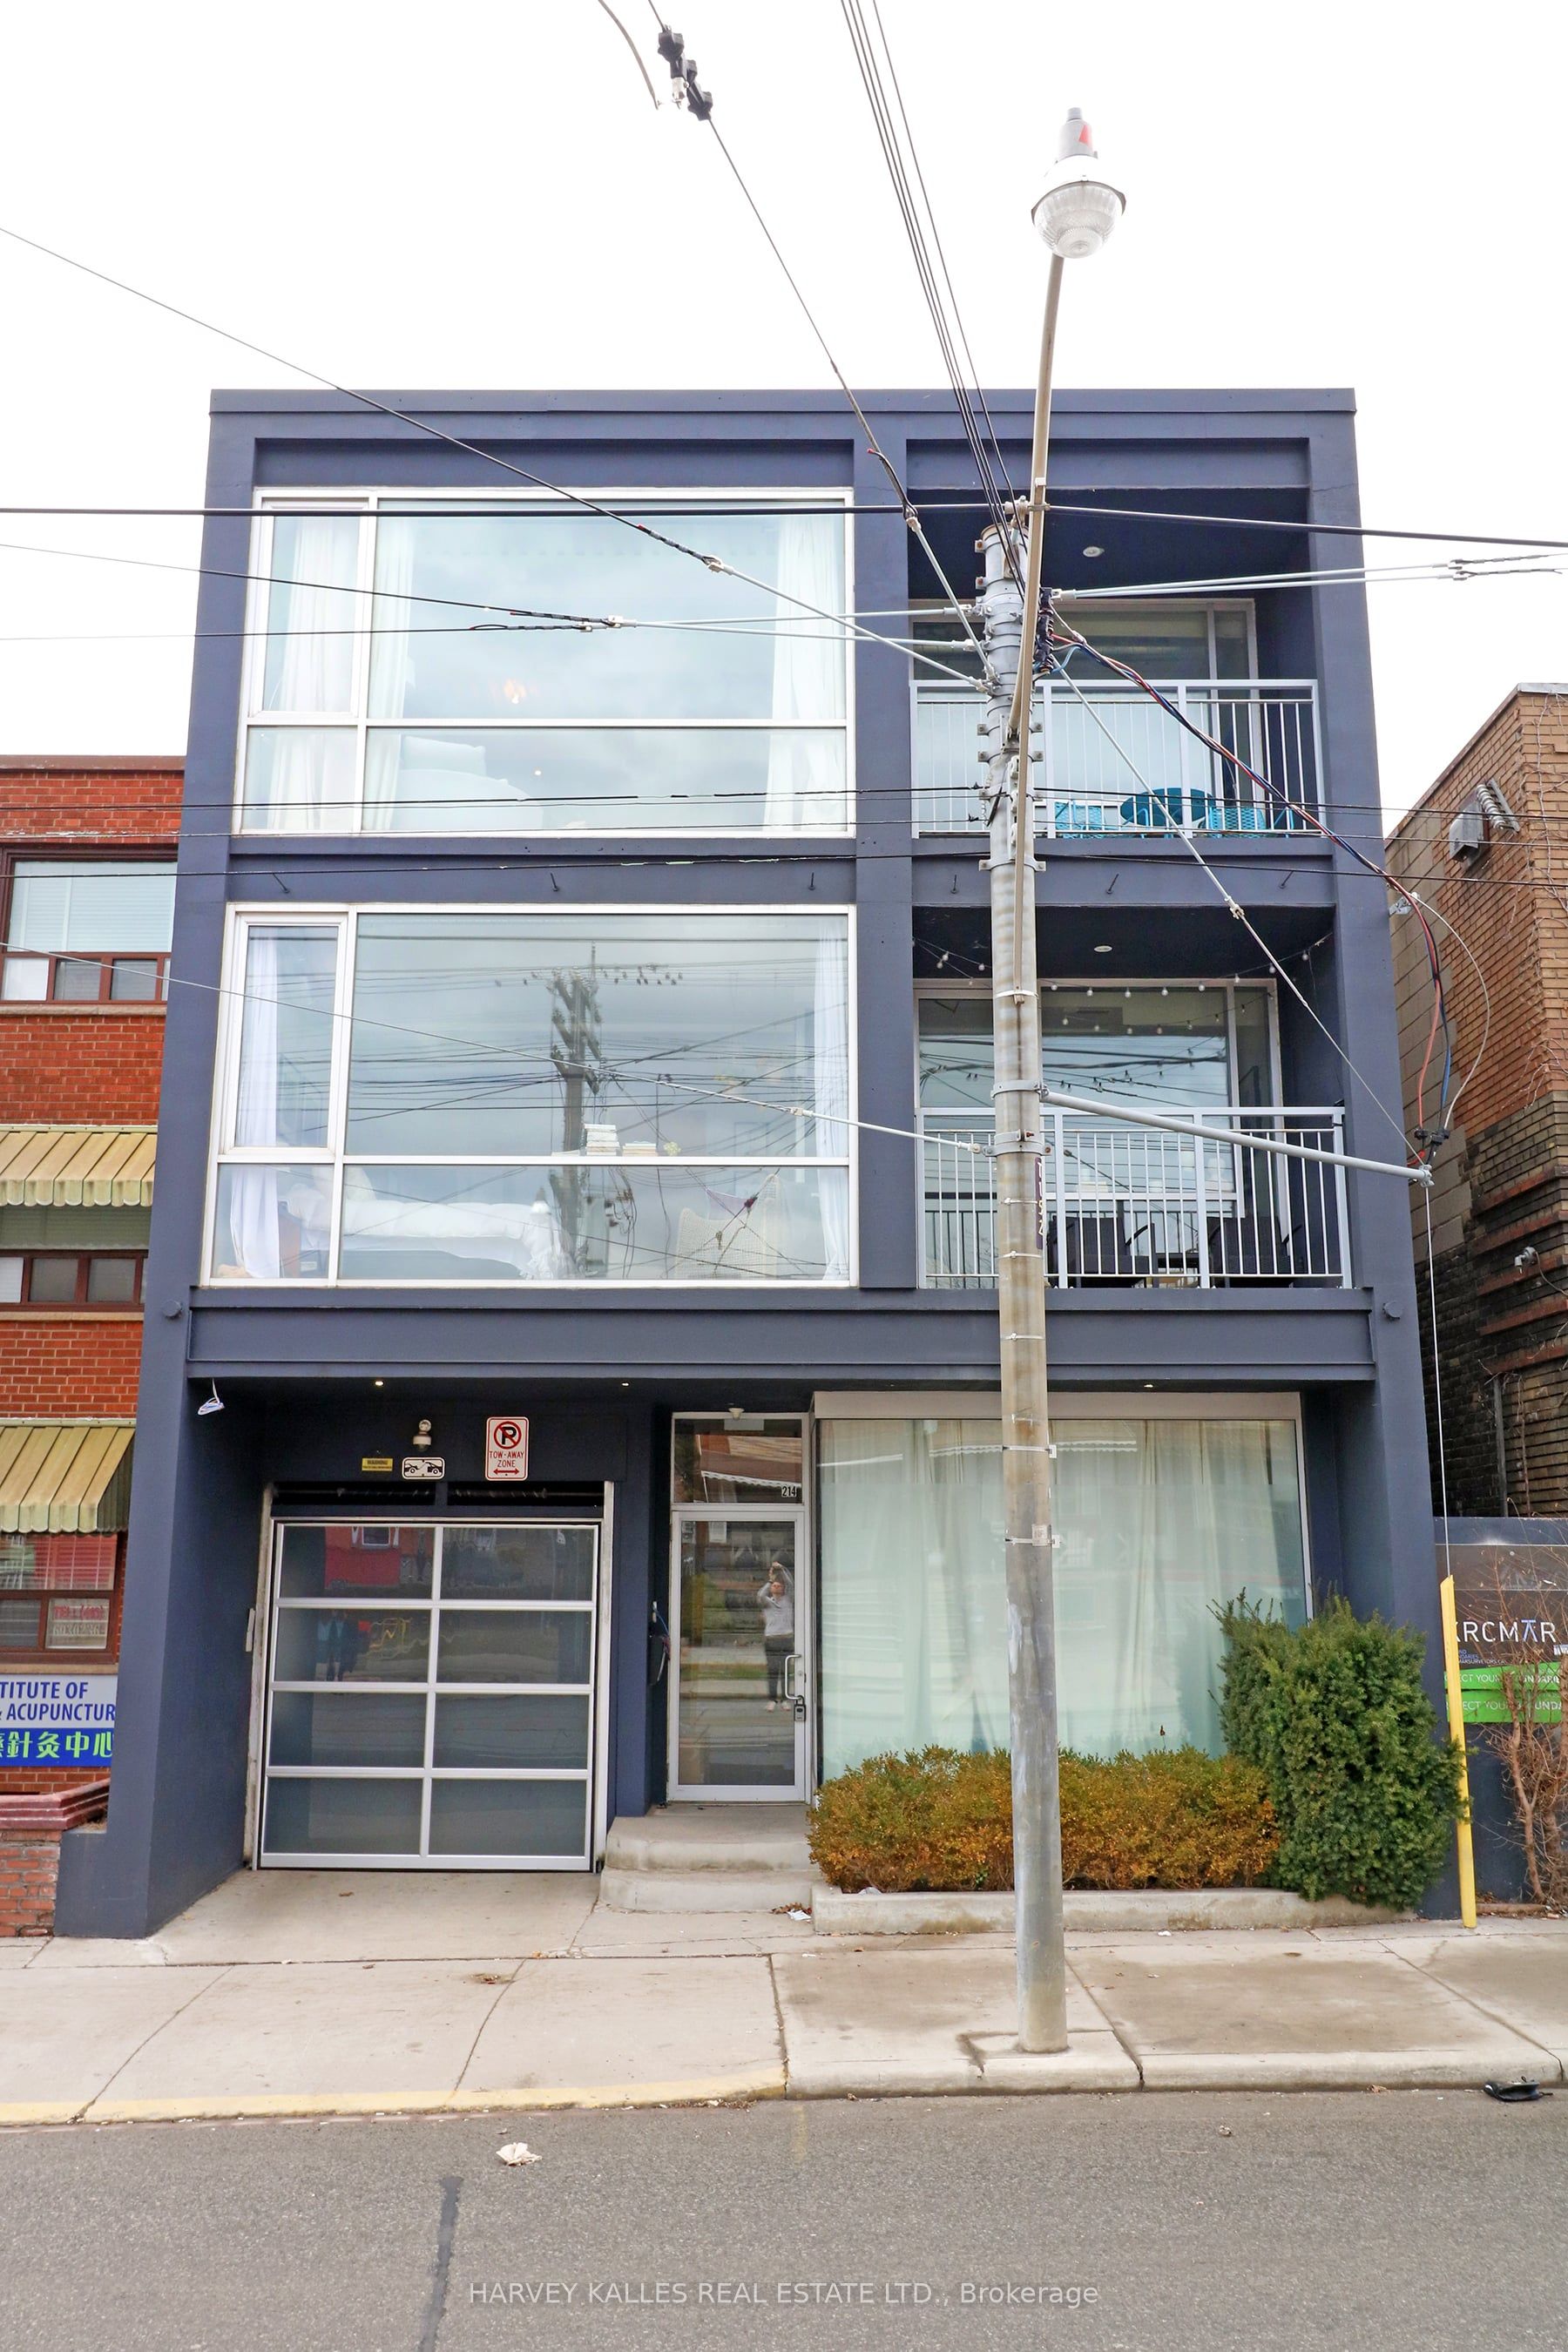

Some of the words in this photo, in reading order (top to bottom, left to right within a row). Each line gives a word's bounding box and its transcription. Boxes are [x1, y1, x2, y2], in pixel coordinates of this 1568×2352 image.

[497, 1459, 516, 1468] ZONE
[781, 1485, 796, 1497] 214
[65, 1681, 89, 1699] OF
[6, 1703, 116, 1721] ACUPUNCTUR
[0, 1731, 113, 1759] 針灸中心
